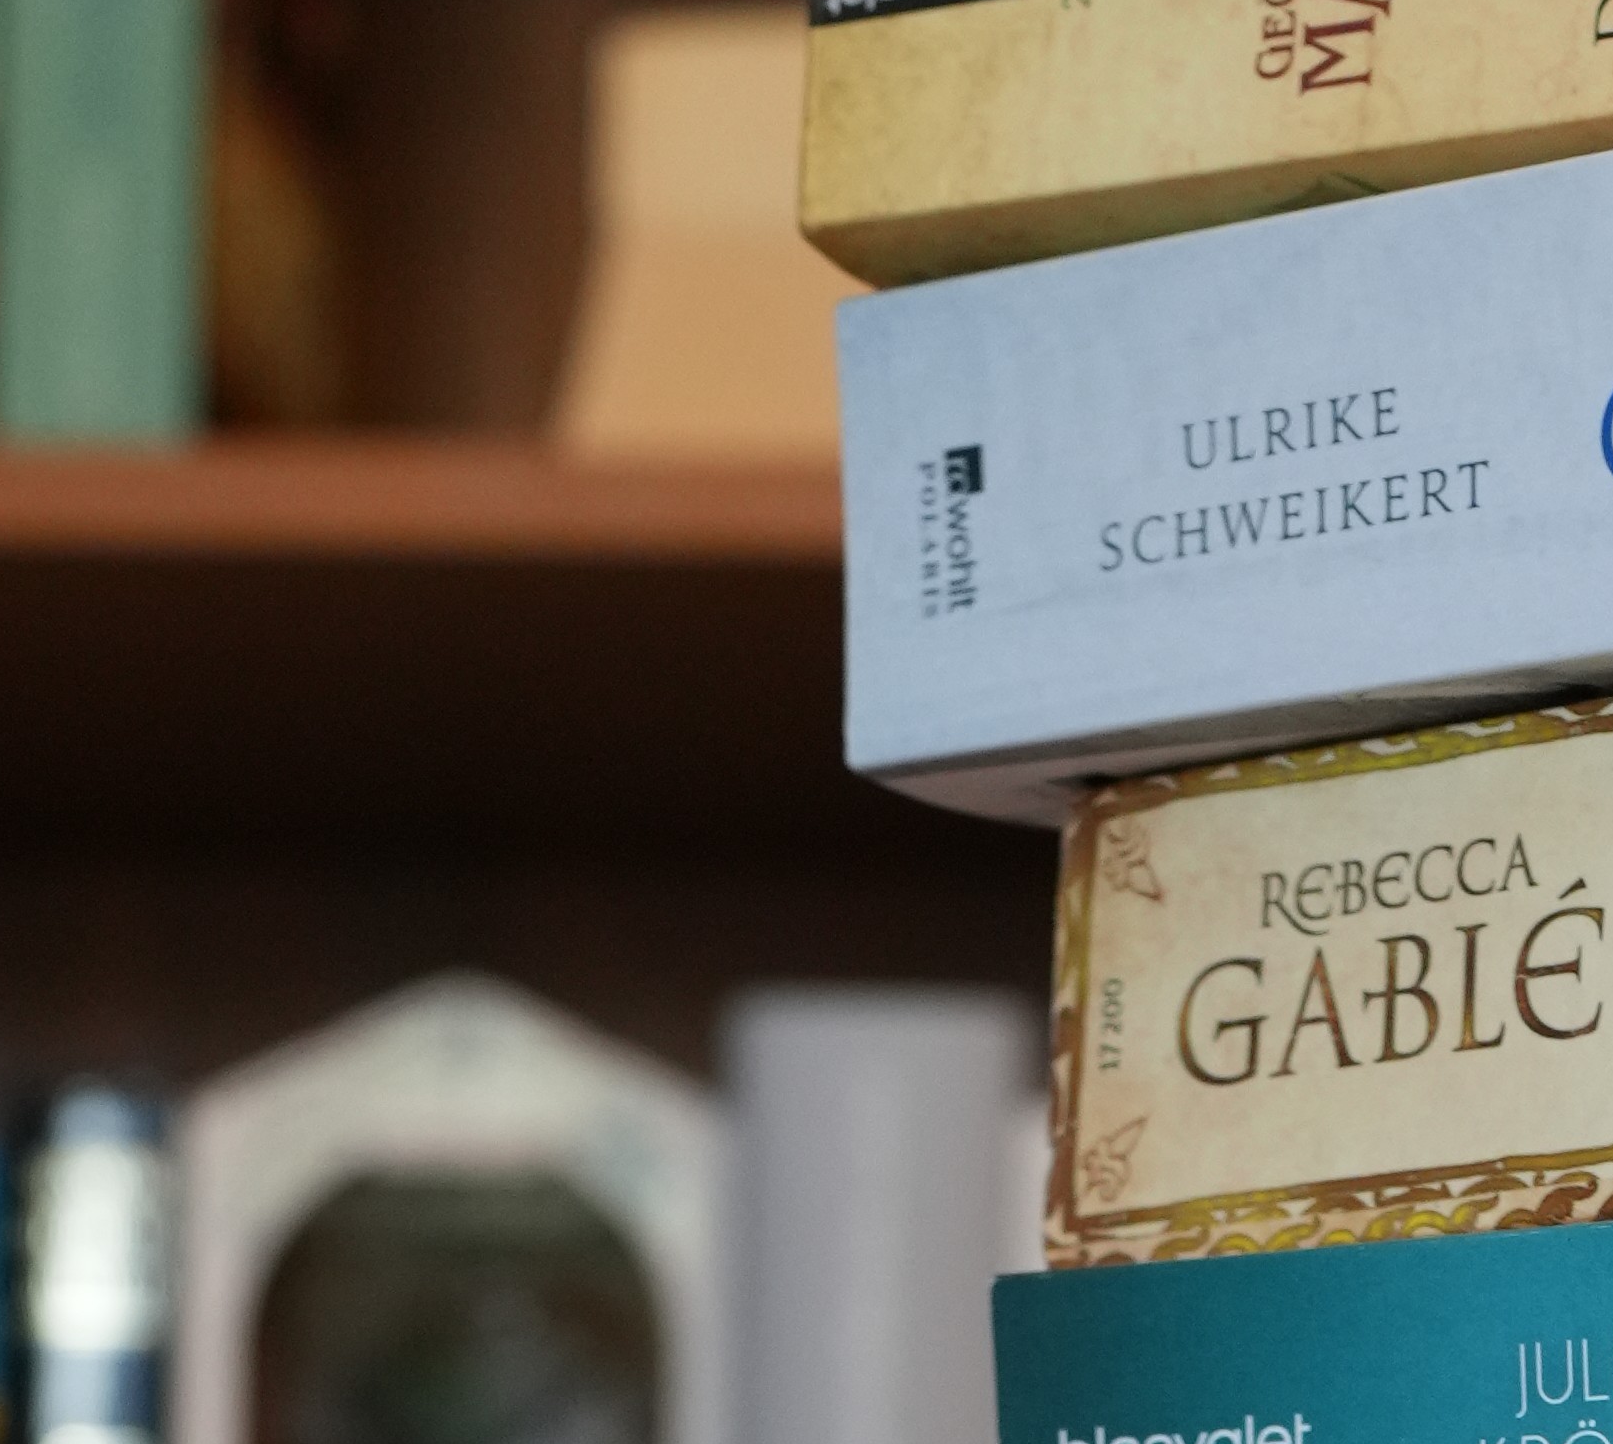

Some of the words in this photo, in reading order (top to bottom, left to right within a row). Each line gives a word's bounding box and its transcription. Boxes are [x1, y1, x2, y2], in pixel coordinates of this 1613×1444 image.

[1180, 388, 1401, 471] ULRIKE
[1098, 459, 1491, 573] SCHWEIKERT
[1260, 833, 1540, 937] REBECCA
[1176, 877, 1605, 1087] GABLÉ
